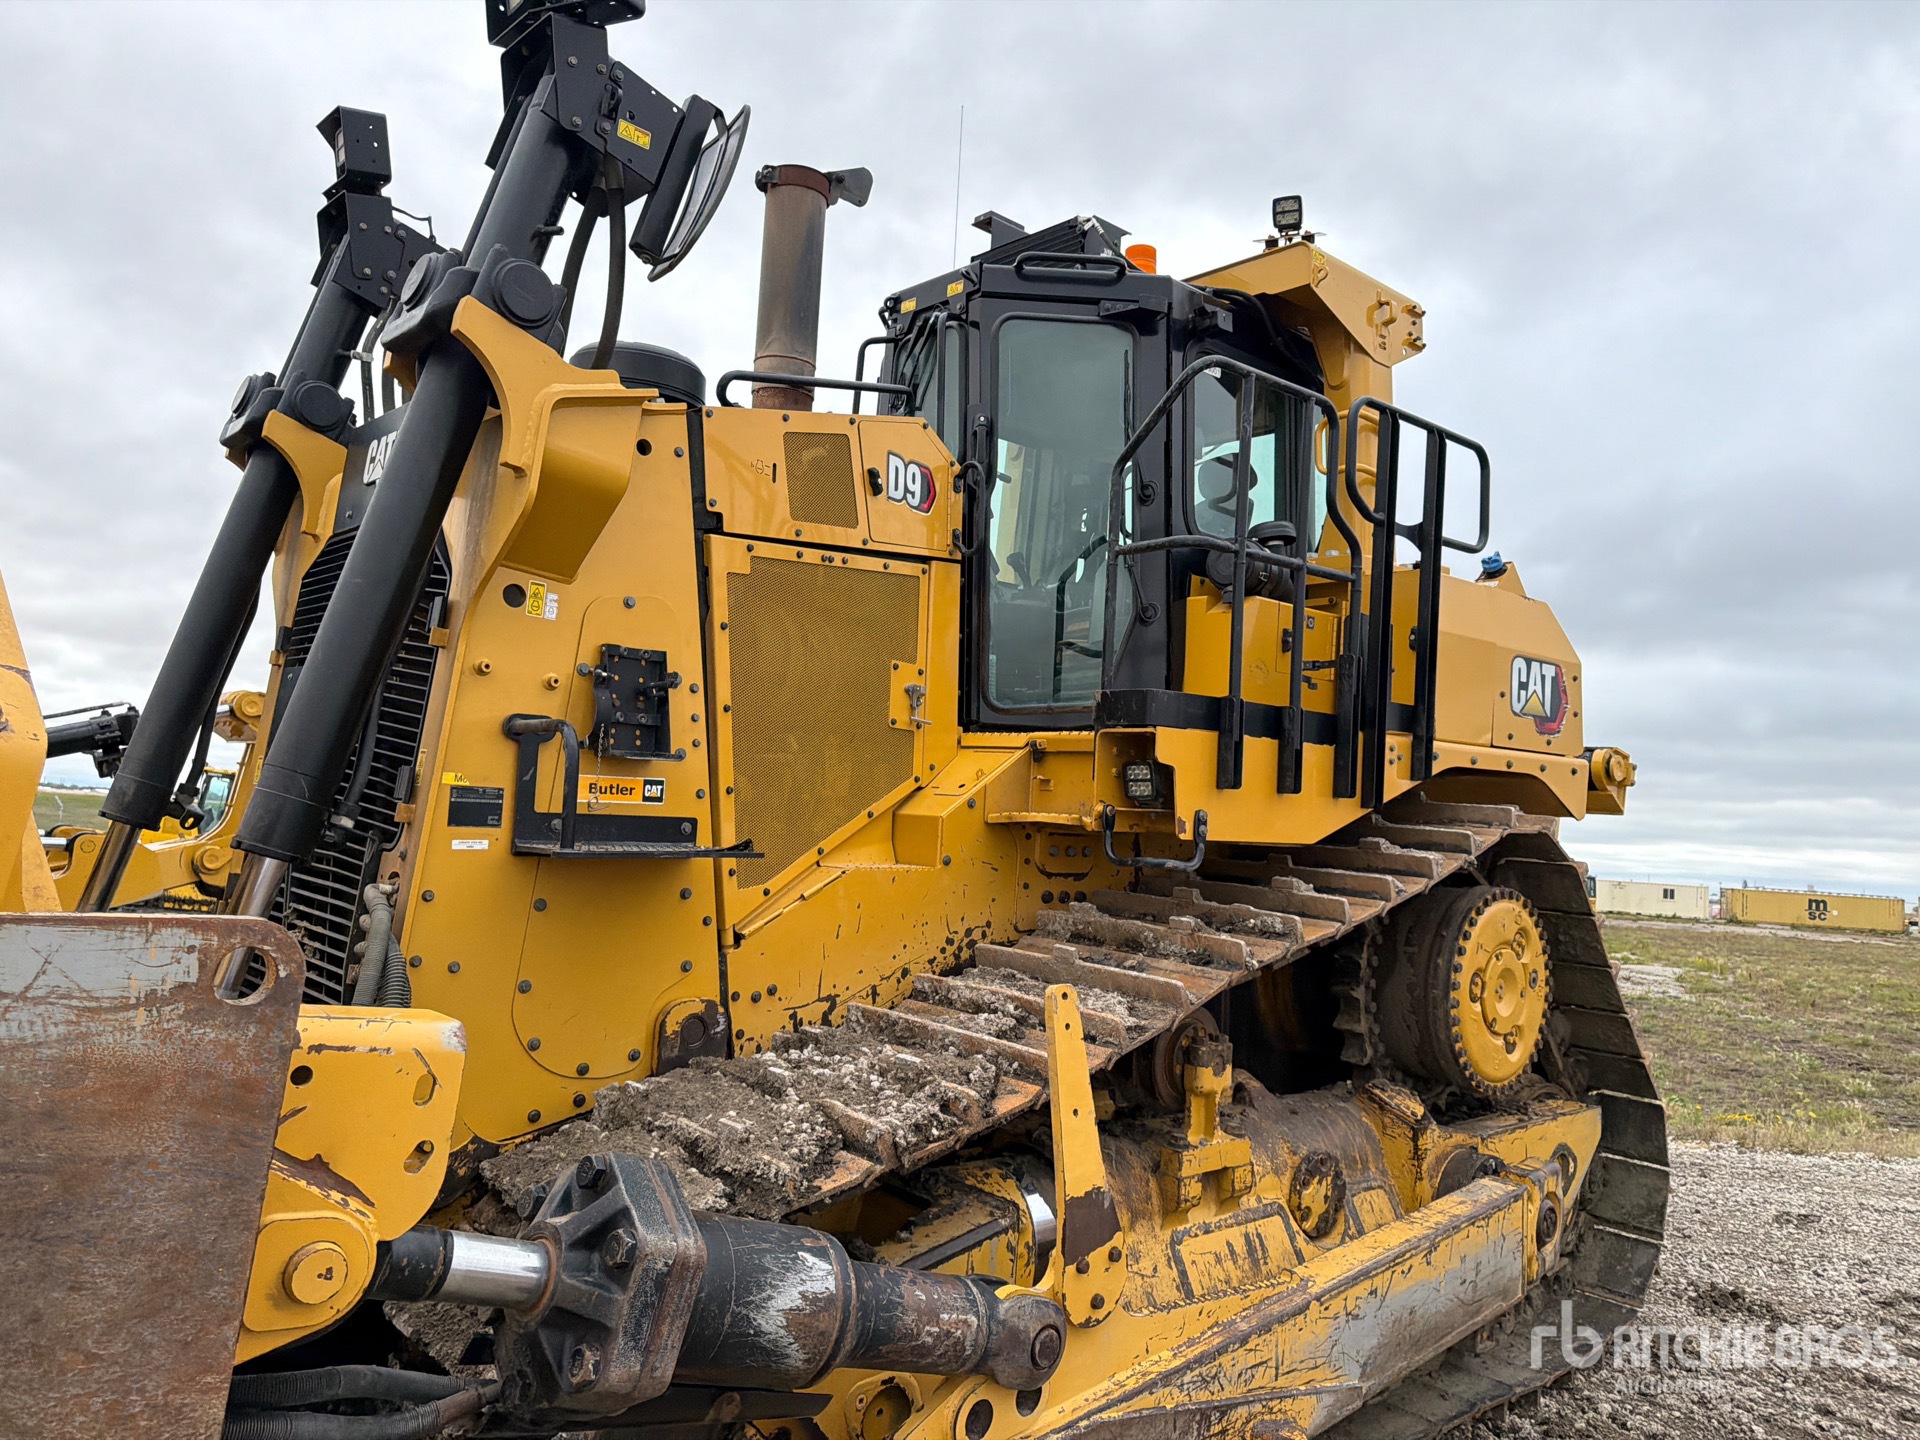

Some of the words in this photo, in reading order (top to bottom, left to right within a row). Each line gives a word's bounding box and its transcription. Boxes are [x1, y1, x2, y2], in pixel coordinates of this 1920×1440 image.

[363, 431, 397, 484] CAT
[888, 452, 922, 507] D9
[1511, 656, 1556, 718] CAT
[588, 782, 636, 796] Butler
[644, 784, 663, 798] CAT
